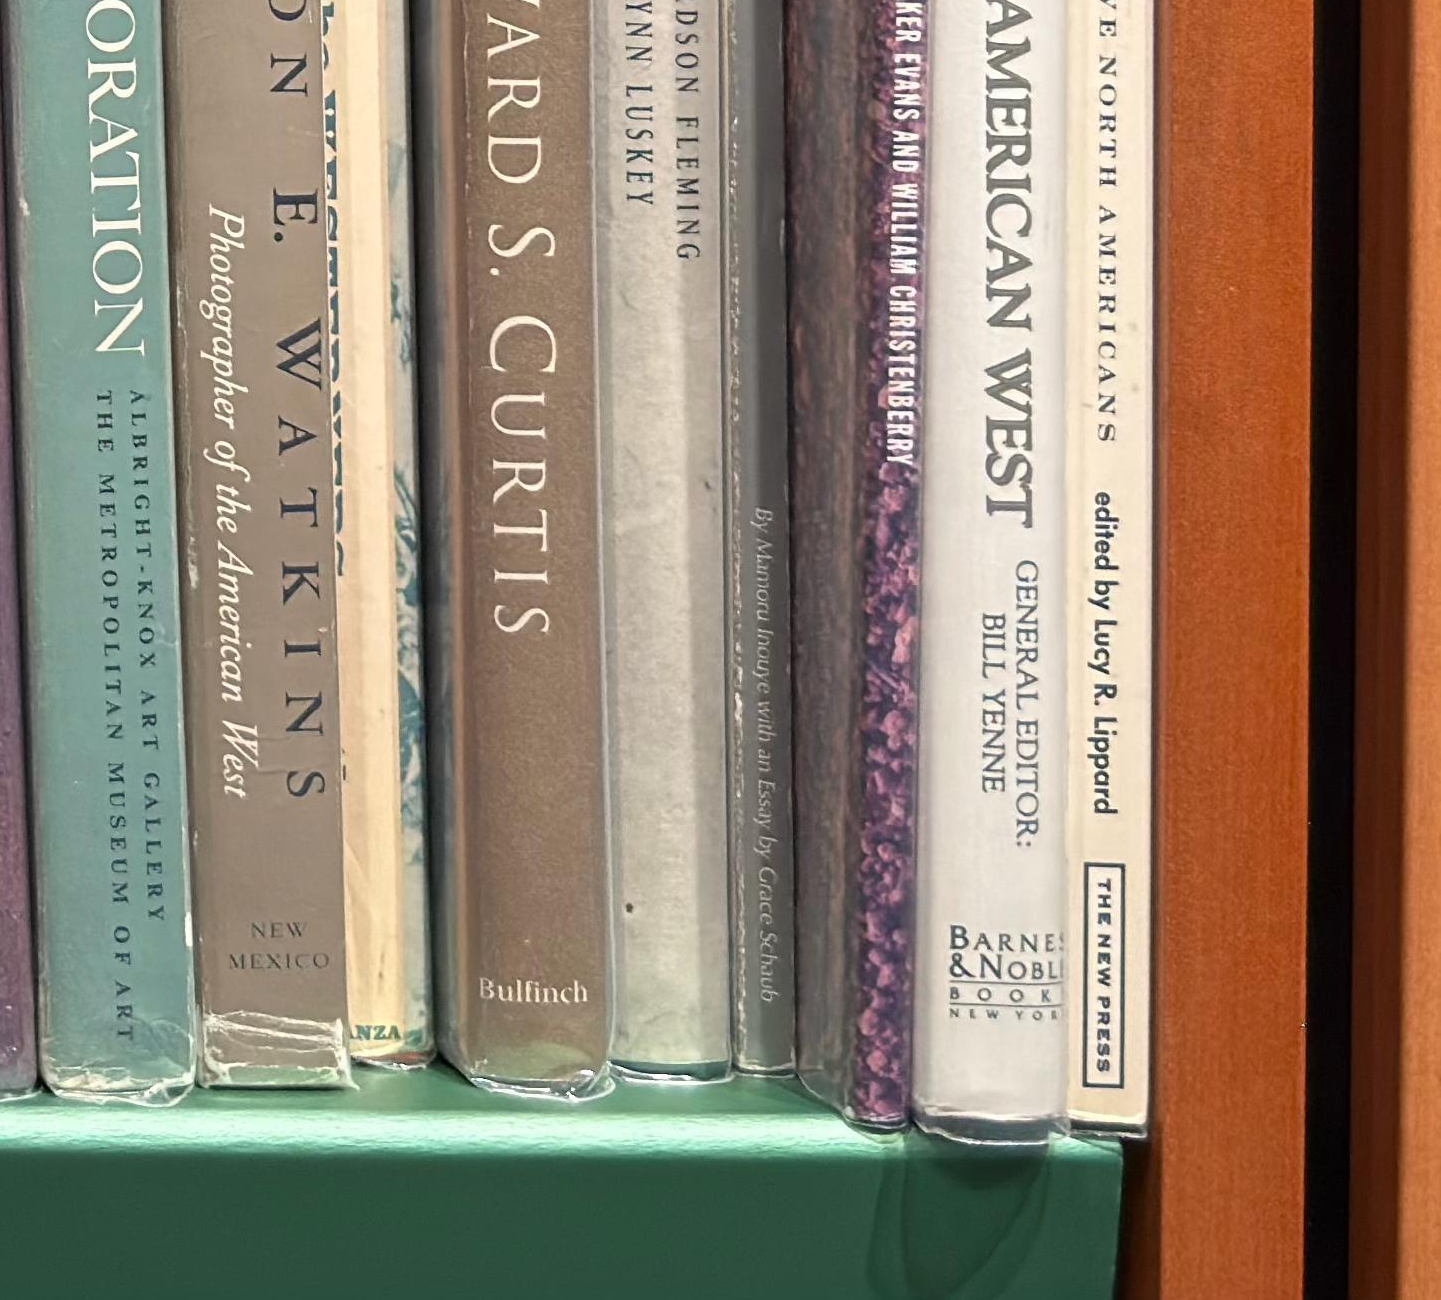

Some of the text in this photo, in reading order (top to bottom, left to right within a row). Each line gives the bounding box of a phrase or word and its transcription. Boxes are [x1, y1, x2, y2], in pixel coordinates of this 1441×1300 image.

[272, 187, 321, 243] E.
[675, 115, 702, 262] FLEMING
[486, 223, 558, 277] S.
[488, 315, 556, 633] CURTIS
[984, 348, 1034, 528] WEST
[276, 320, 327, 799] WATKINS
[1087, 492, 1118, 814] edited by Lucy R. Lippard
[229, 952, 330, 970] MEXICO
[251, 921, 309, 939] NEW
[478, 976, 589, 1004] Bulfinch
